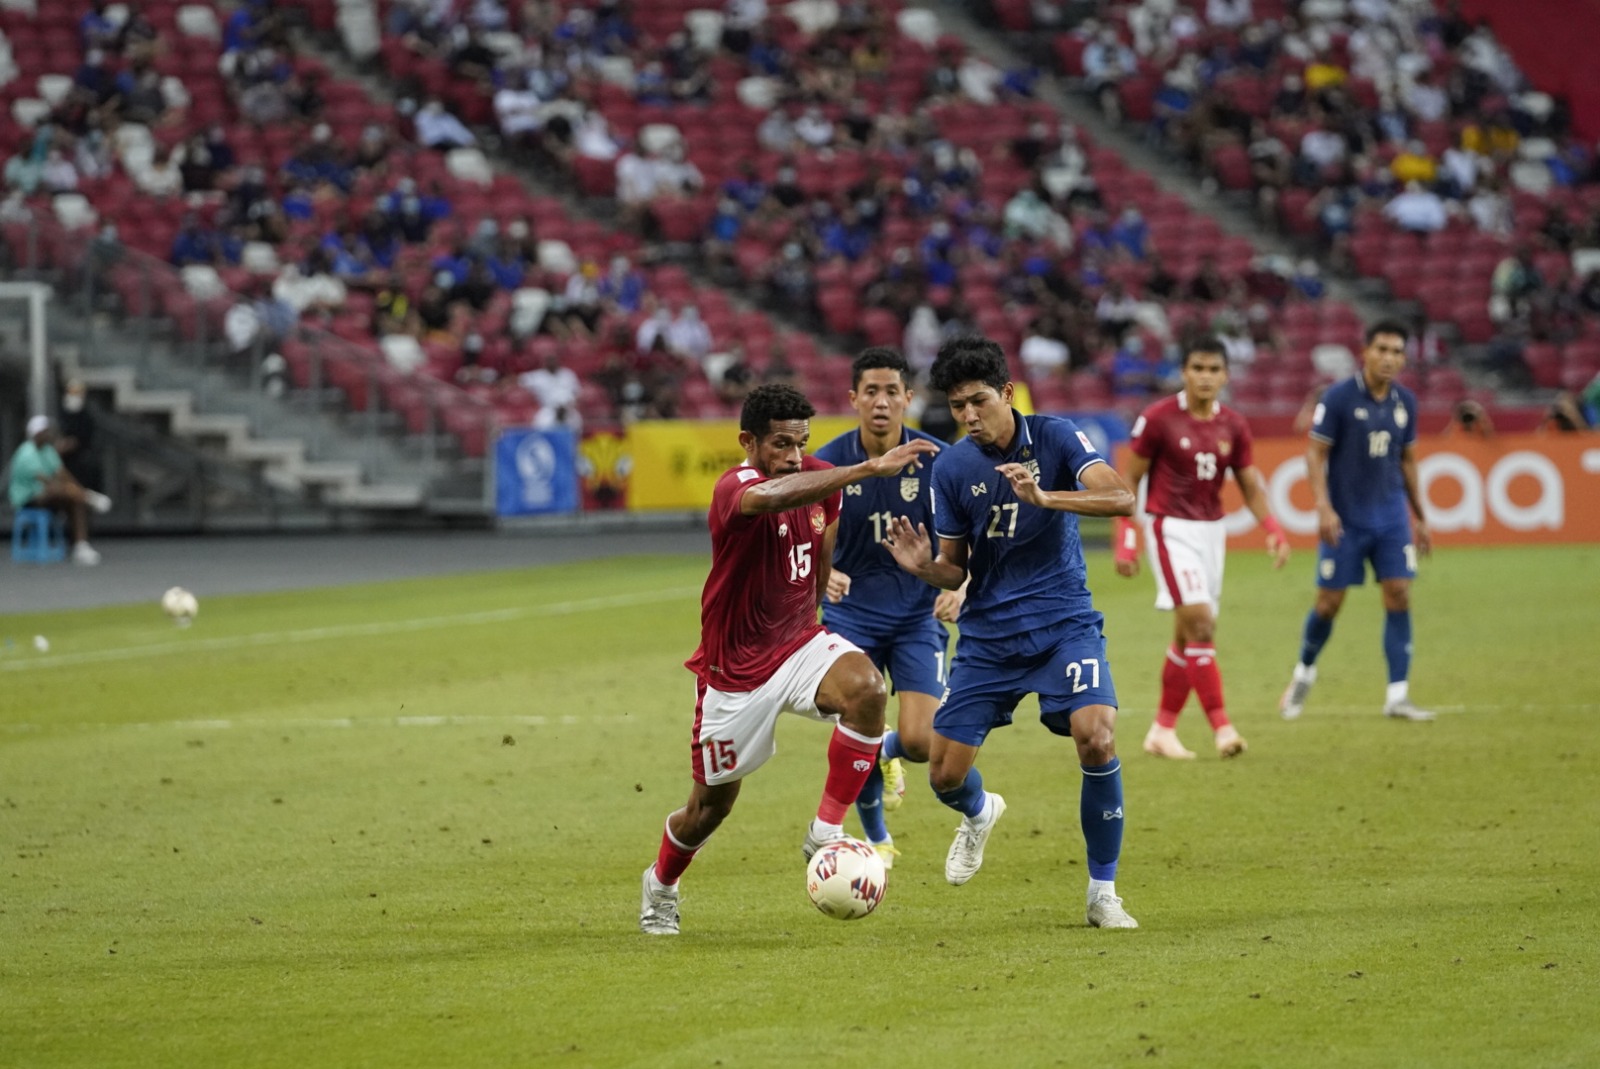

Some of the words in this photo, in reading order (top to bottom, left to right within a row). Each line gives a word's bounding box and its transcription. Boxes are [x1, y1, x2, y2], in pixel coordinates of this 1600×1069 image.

[1368, 430, 1391, 457] 10
[1194, 452, 1217, 480] 13
[868, 511, 893, 543] 11
[987, 502, 1019, 538] 27
[788, 541, 811, 581] 15
[1066, 658, 1100, 693] 27
[706, 739, 737, 774] 15
